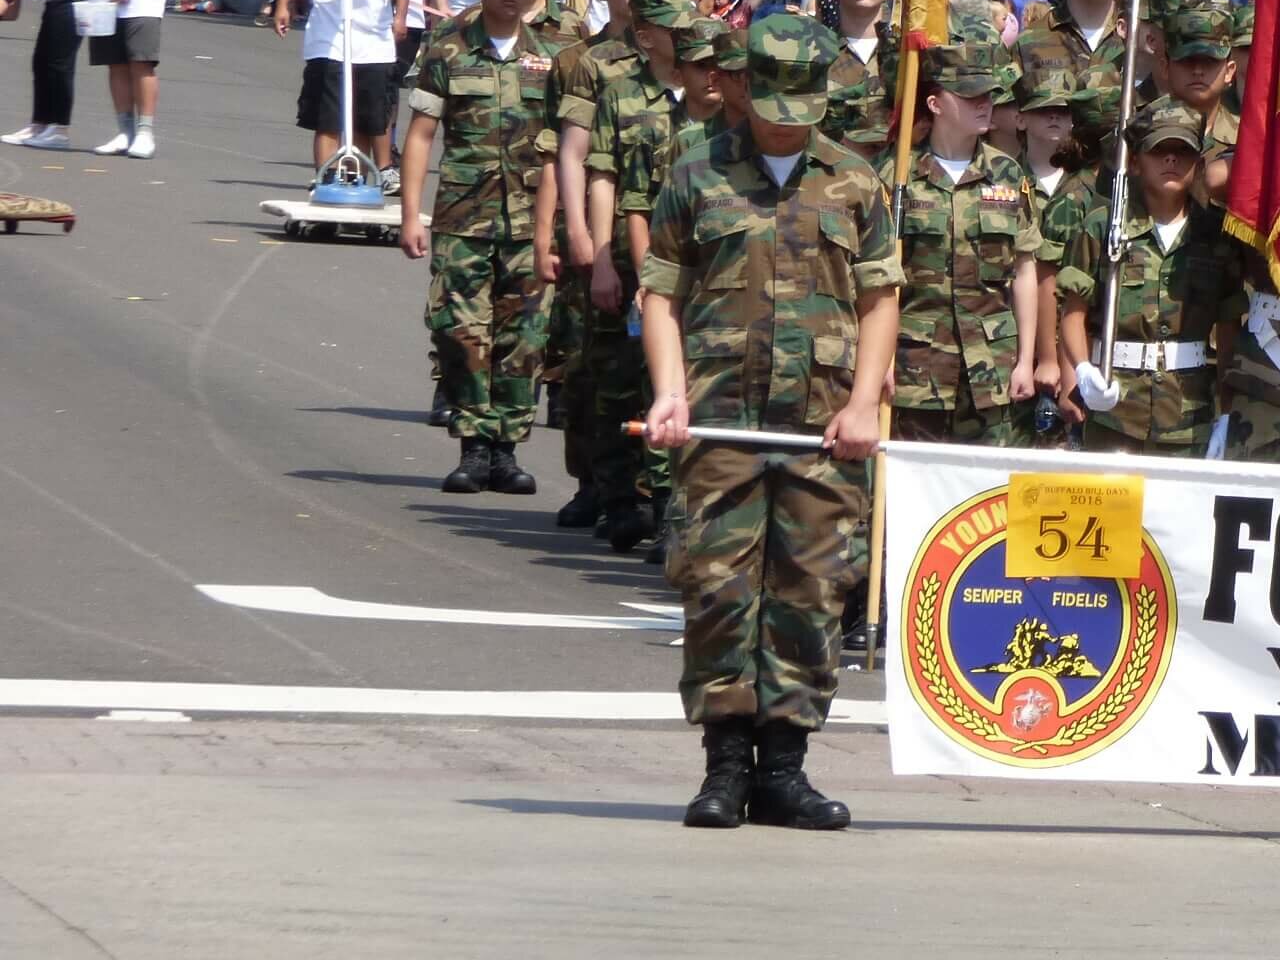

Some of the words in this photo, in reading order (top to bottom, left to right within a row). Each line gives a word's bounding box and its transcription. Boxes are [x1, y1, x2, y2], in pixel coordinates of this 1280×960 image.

[939, 500, 1008, 557] YOUN
[1035, 511, 1112, 562] 54
[962, 587, 1023, 605] SEMPER
[1052, 591, 1108, 609] FIDELIS
